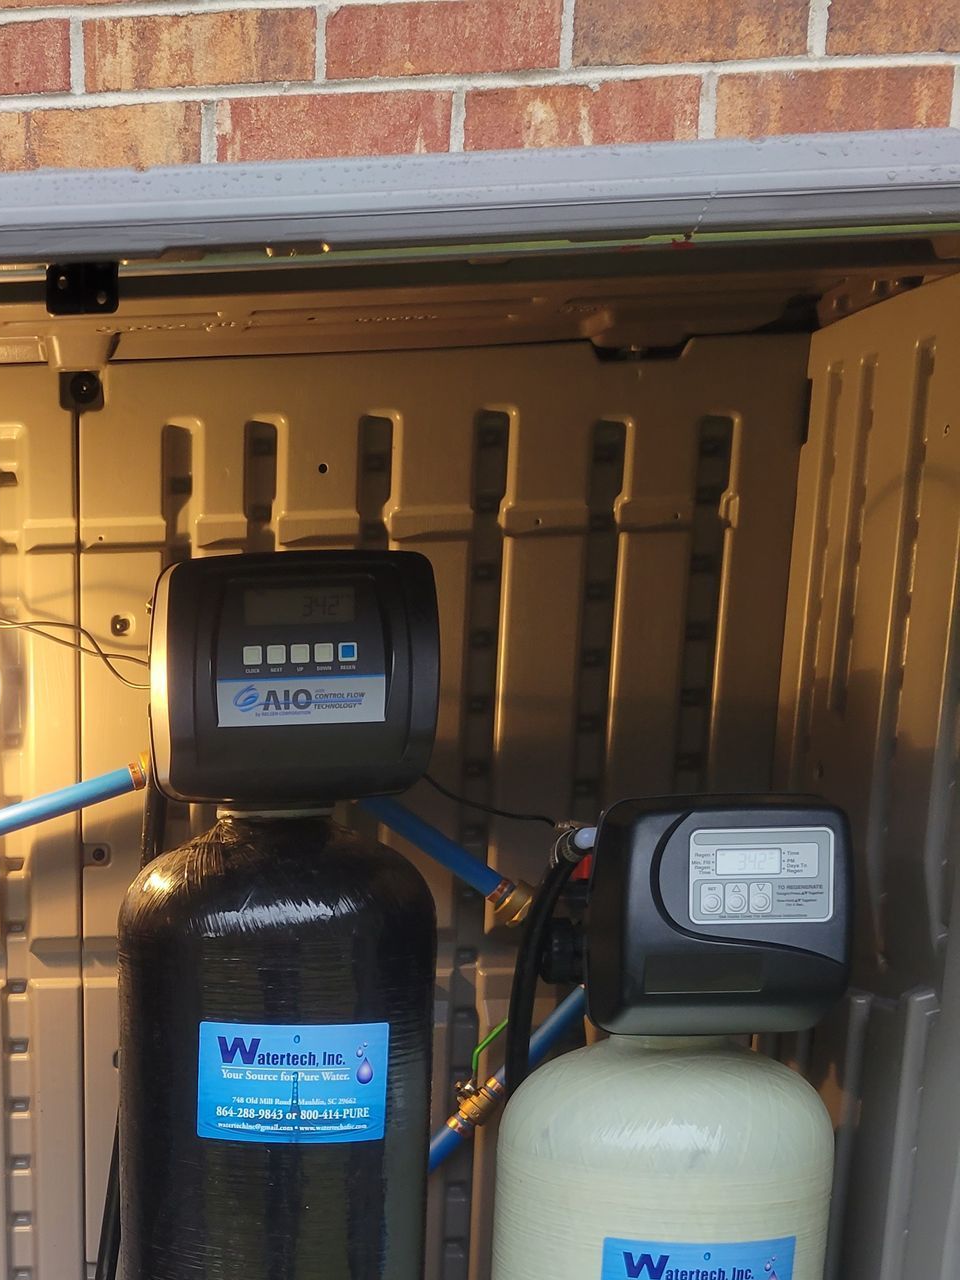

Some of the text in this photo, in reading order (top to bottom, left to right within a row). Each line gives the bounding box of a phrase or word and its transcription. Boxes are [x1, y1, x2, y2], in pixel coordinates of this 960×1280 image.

[262, 688, 313, 711] AIO
[314, 691, 366, 700] CONTROL FLOW
[217, 1035, 346, 1067] Watertech, Inc.
[220, 1069, 350, 1081] Your Source for Pure Water.
[245, 1096, 259, 1104] Old
[259, 1097, 274, 1105] Mill
[216, 1106, 370, 1120] 864-288-9843 or 800-414-PURE
[731, 1267, 755, 1280] Inc.
